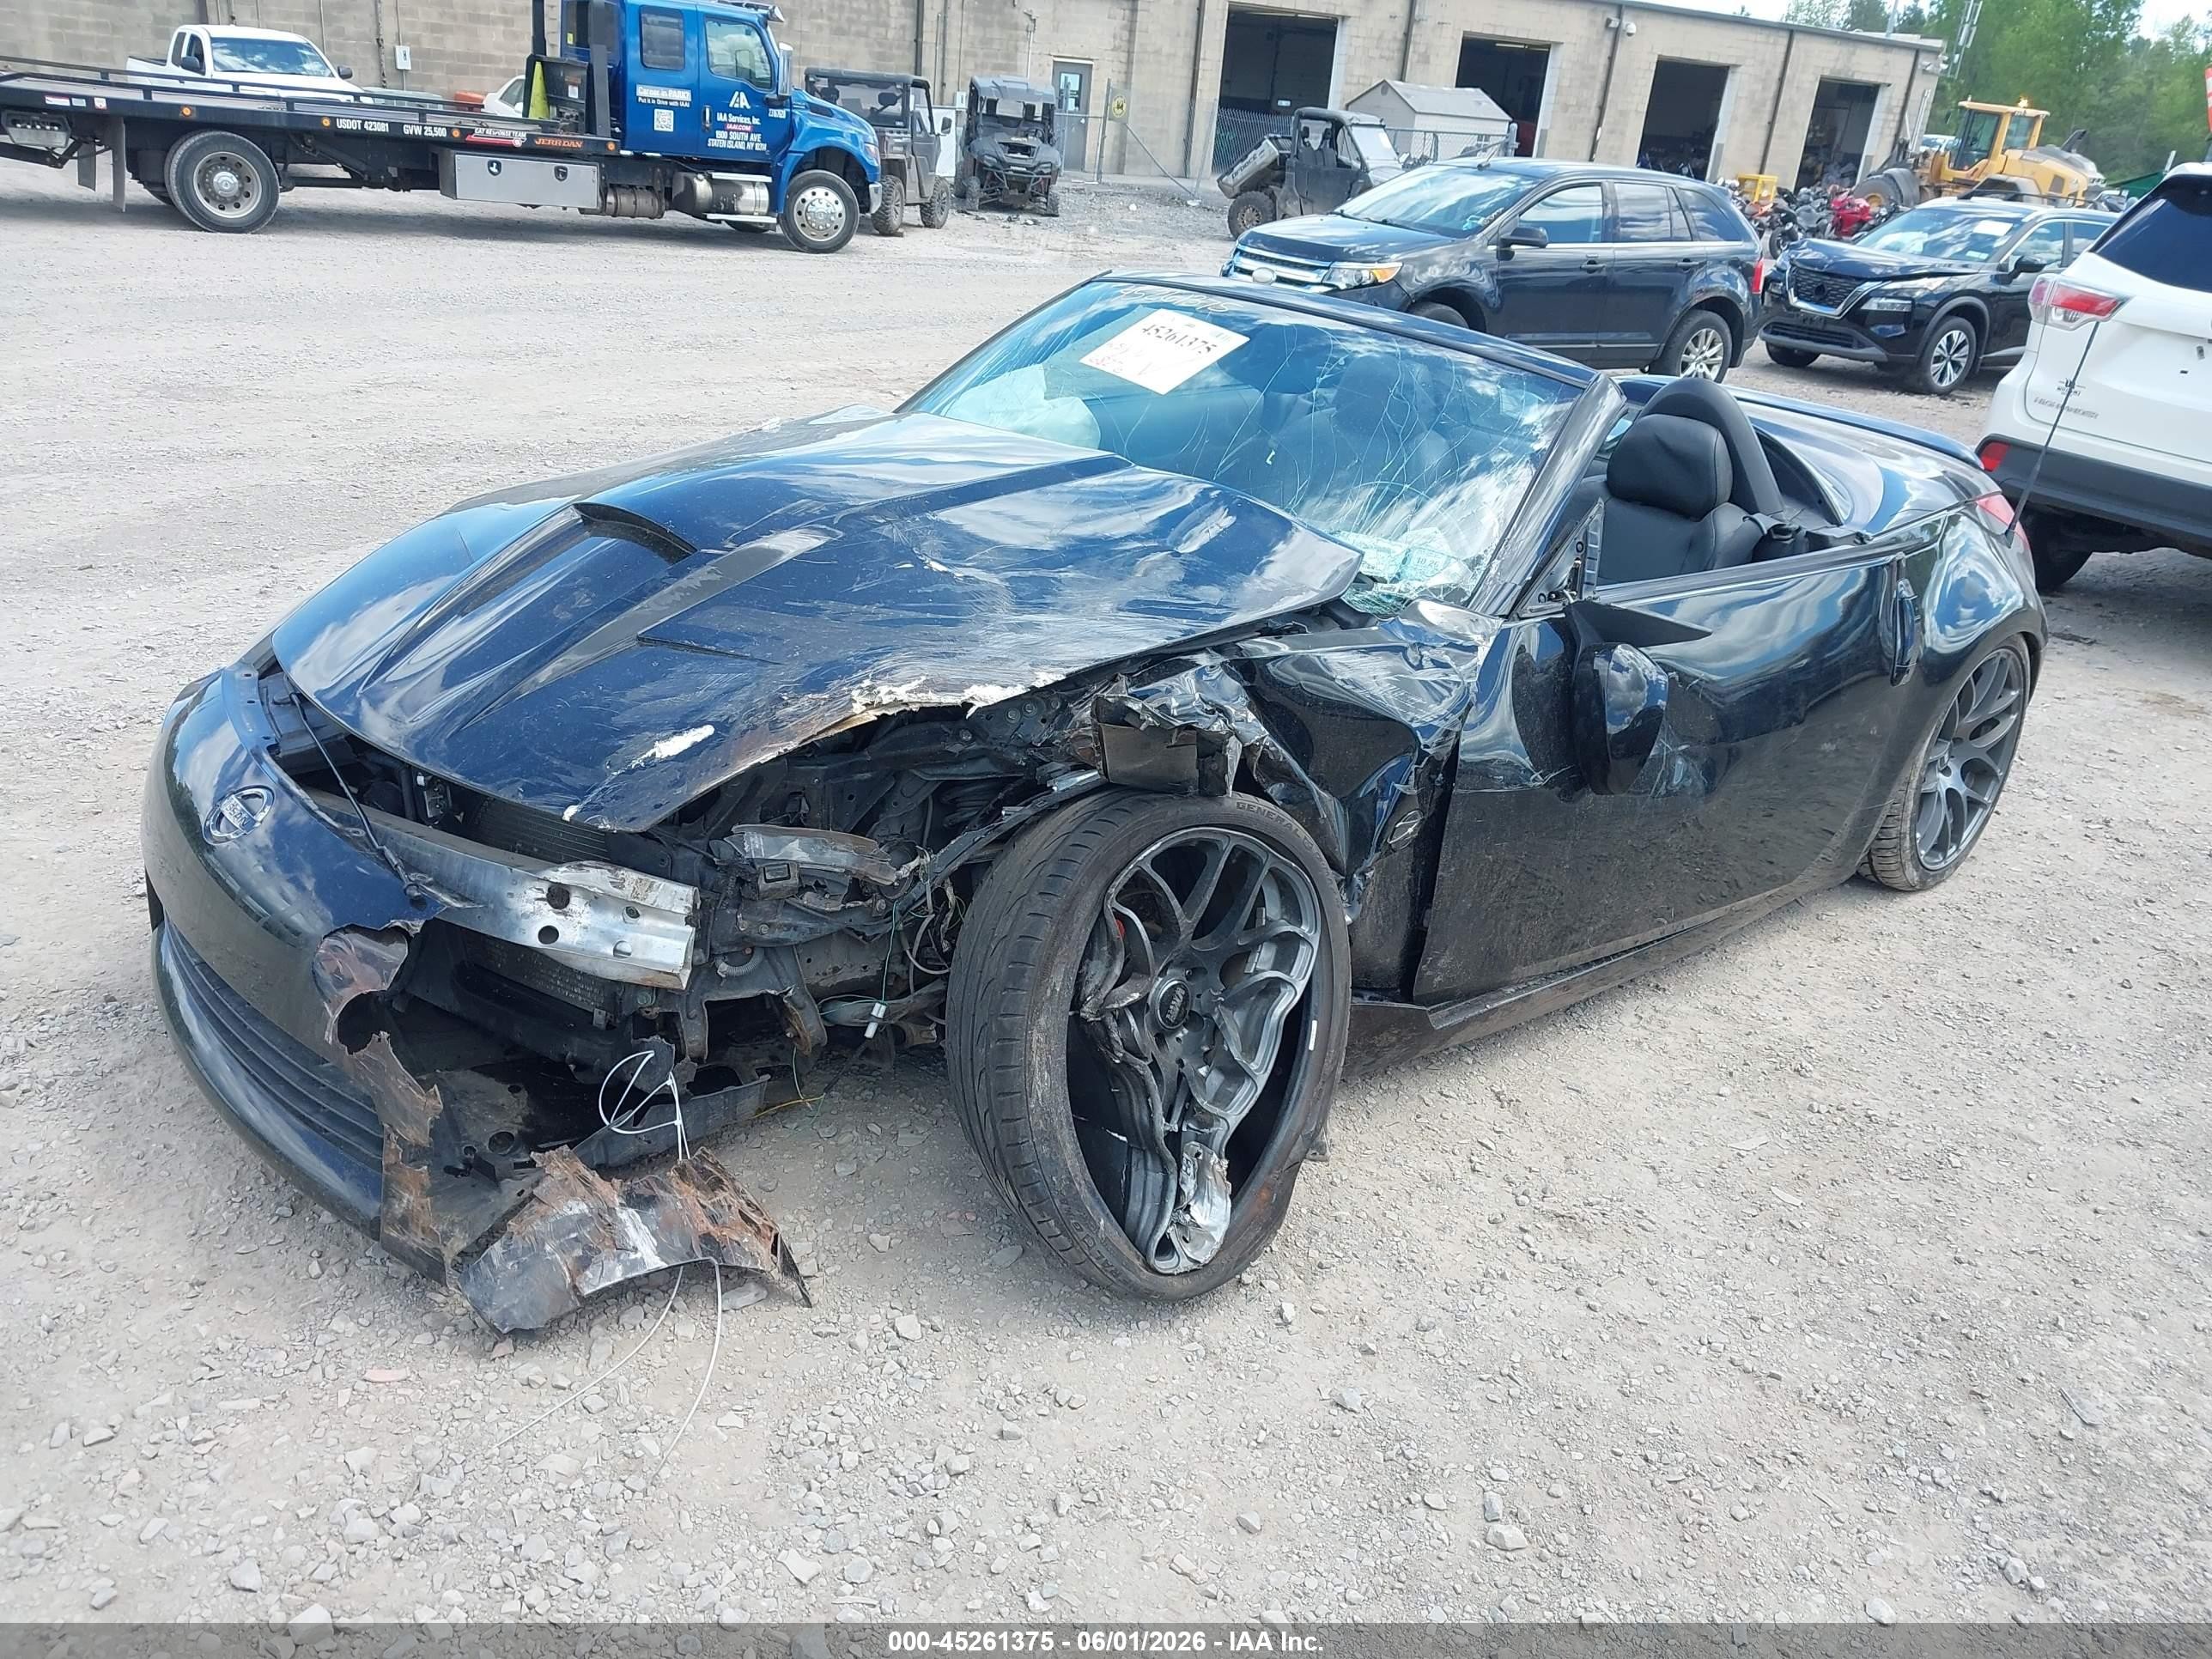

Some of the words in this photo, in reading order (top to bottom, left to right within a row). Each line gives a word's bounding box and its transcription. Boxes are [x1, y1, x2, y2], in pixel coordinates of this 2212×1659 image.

[716, 112, 727, 122] IAA
[336, 118, 362, 130] USDOT
[363, 119, 389, 132] 423081
[403, 124, 422, 136] GVW
[423, 125, 447, 137] 25,500
[729, 131, 749, 141] SOUTH
[750, 133, 762, 142] AVE
[708, 138, 726, 148] STATEN
[746, 141, 755, 150] NY
[1141, 324, 1218, 354] 45261375
[1237, 801, 1302, 838] GENERAL
